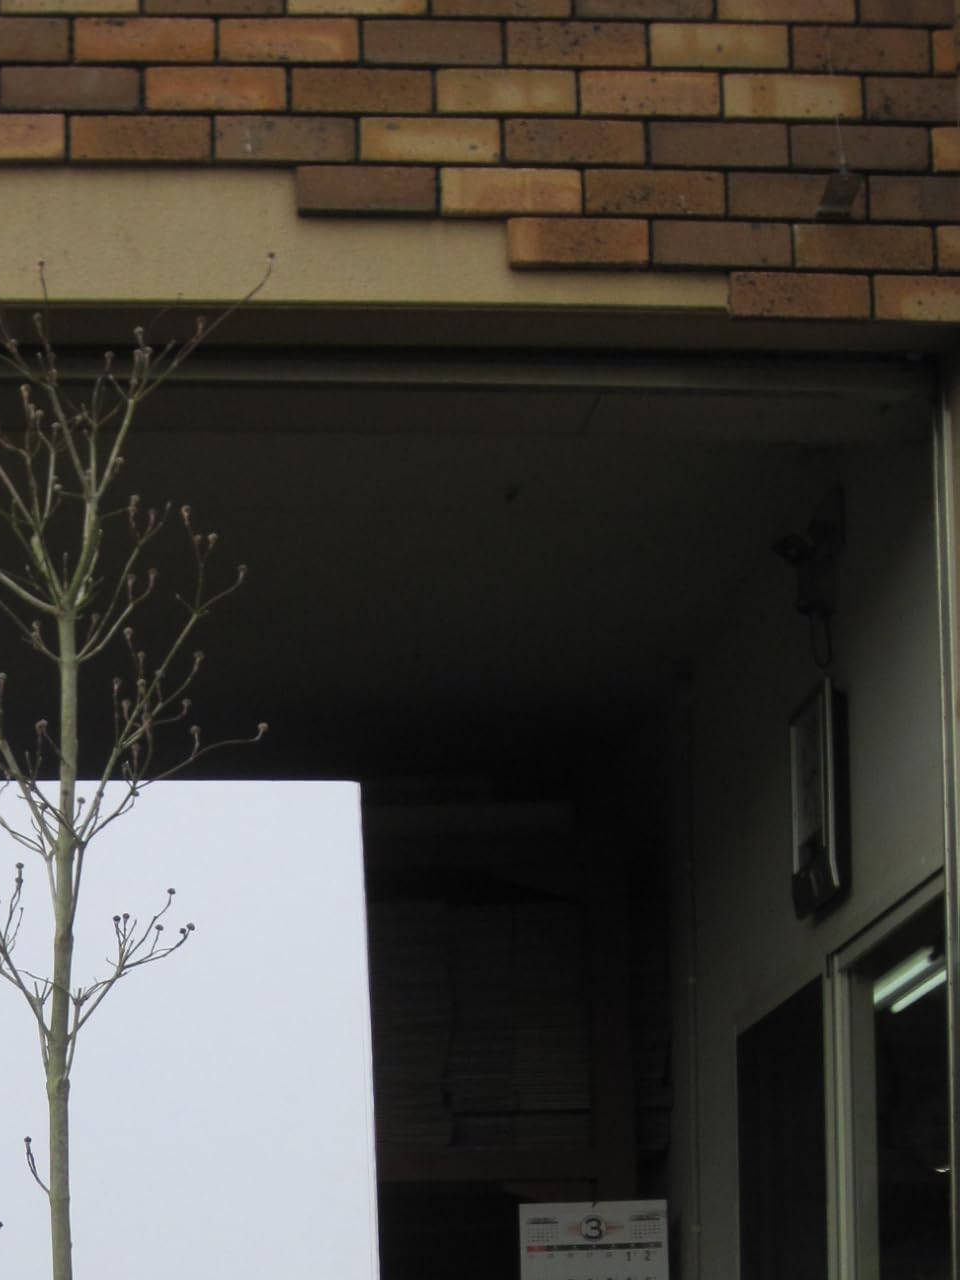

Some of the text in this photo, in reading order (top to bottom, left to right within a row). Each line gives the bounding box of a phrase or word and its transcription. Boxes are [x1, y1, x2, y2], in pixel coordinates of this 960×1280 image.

[584, 1218, 602, 1240] 3
[626, 1252, 651, 1261] 1 2
